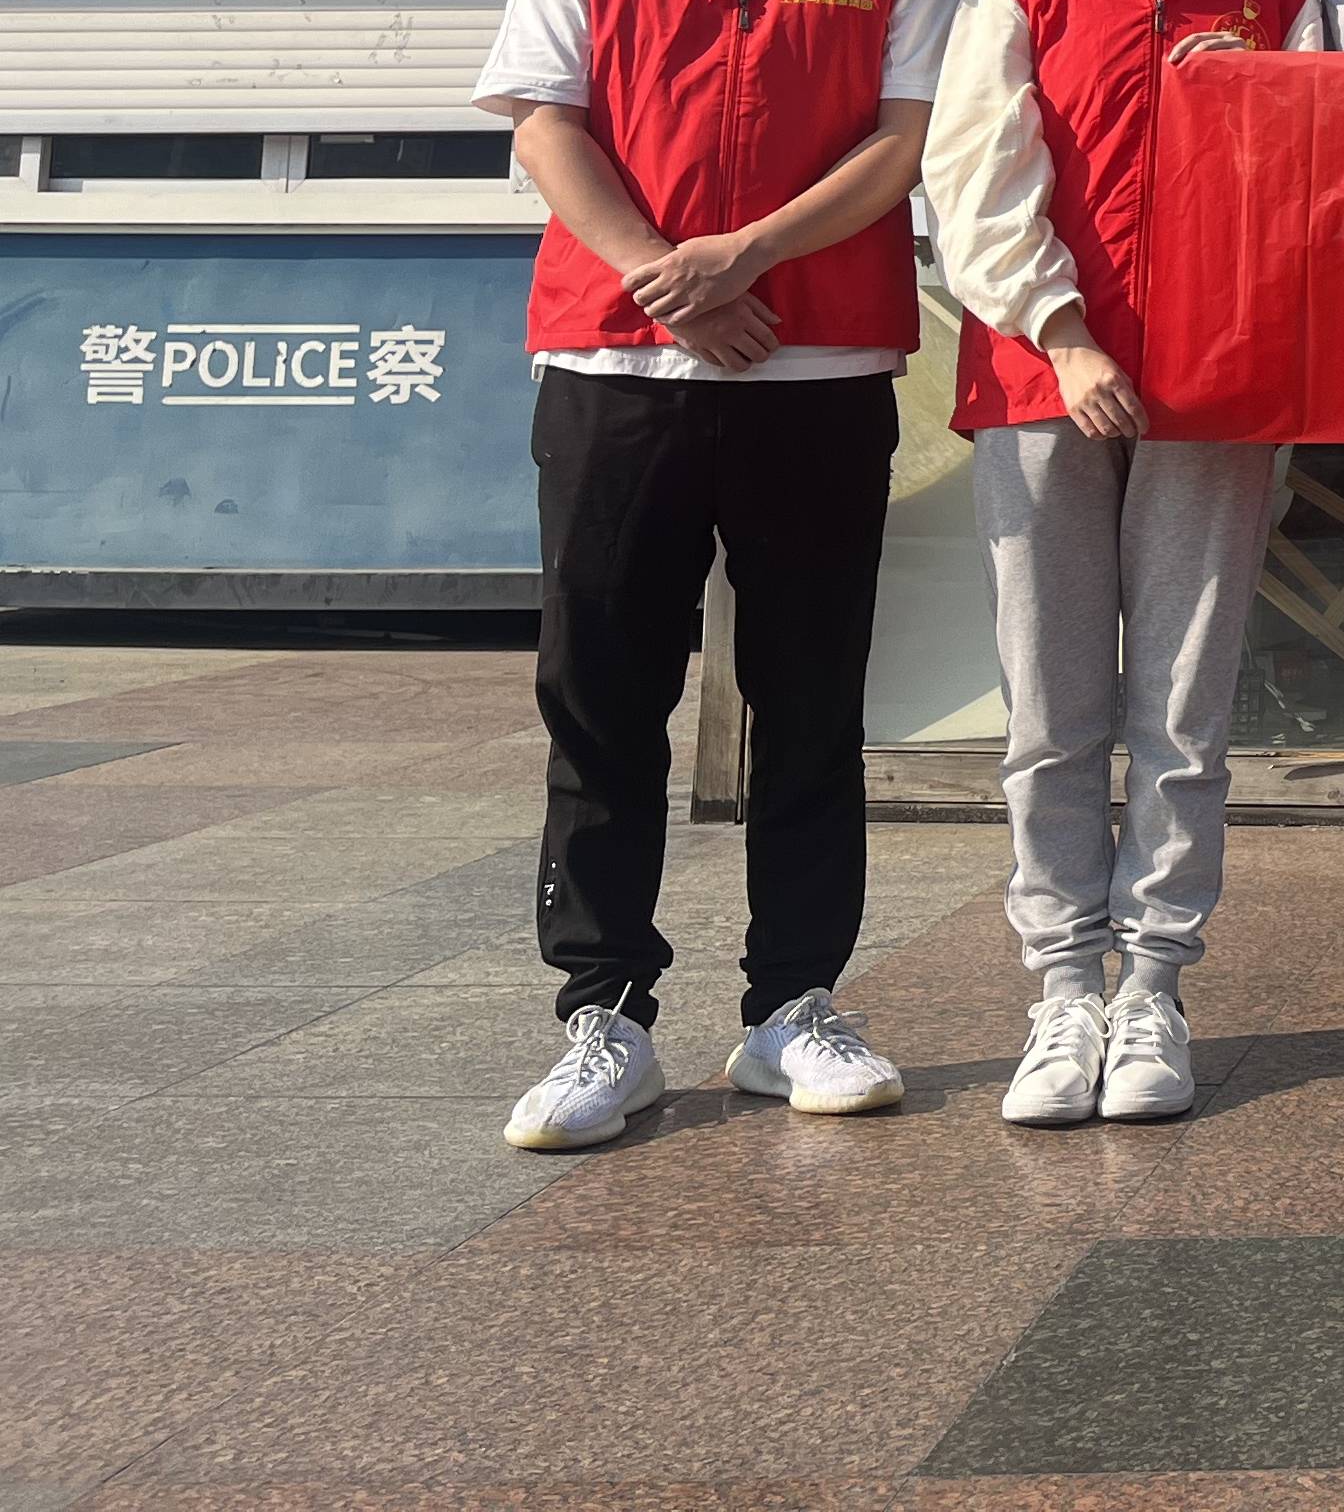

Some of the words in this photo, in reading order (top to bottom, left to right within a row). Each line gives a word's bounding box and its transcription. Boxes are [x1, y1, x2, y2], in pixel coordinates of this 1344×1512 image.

[79, 323, 157, 405] 警
[160, 338, 359, 389] POLICE
[367, 325, 447, 405] 察
